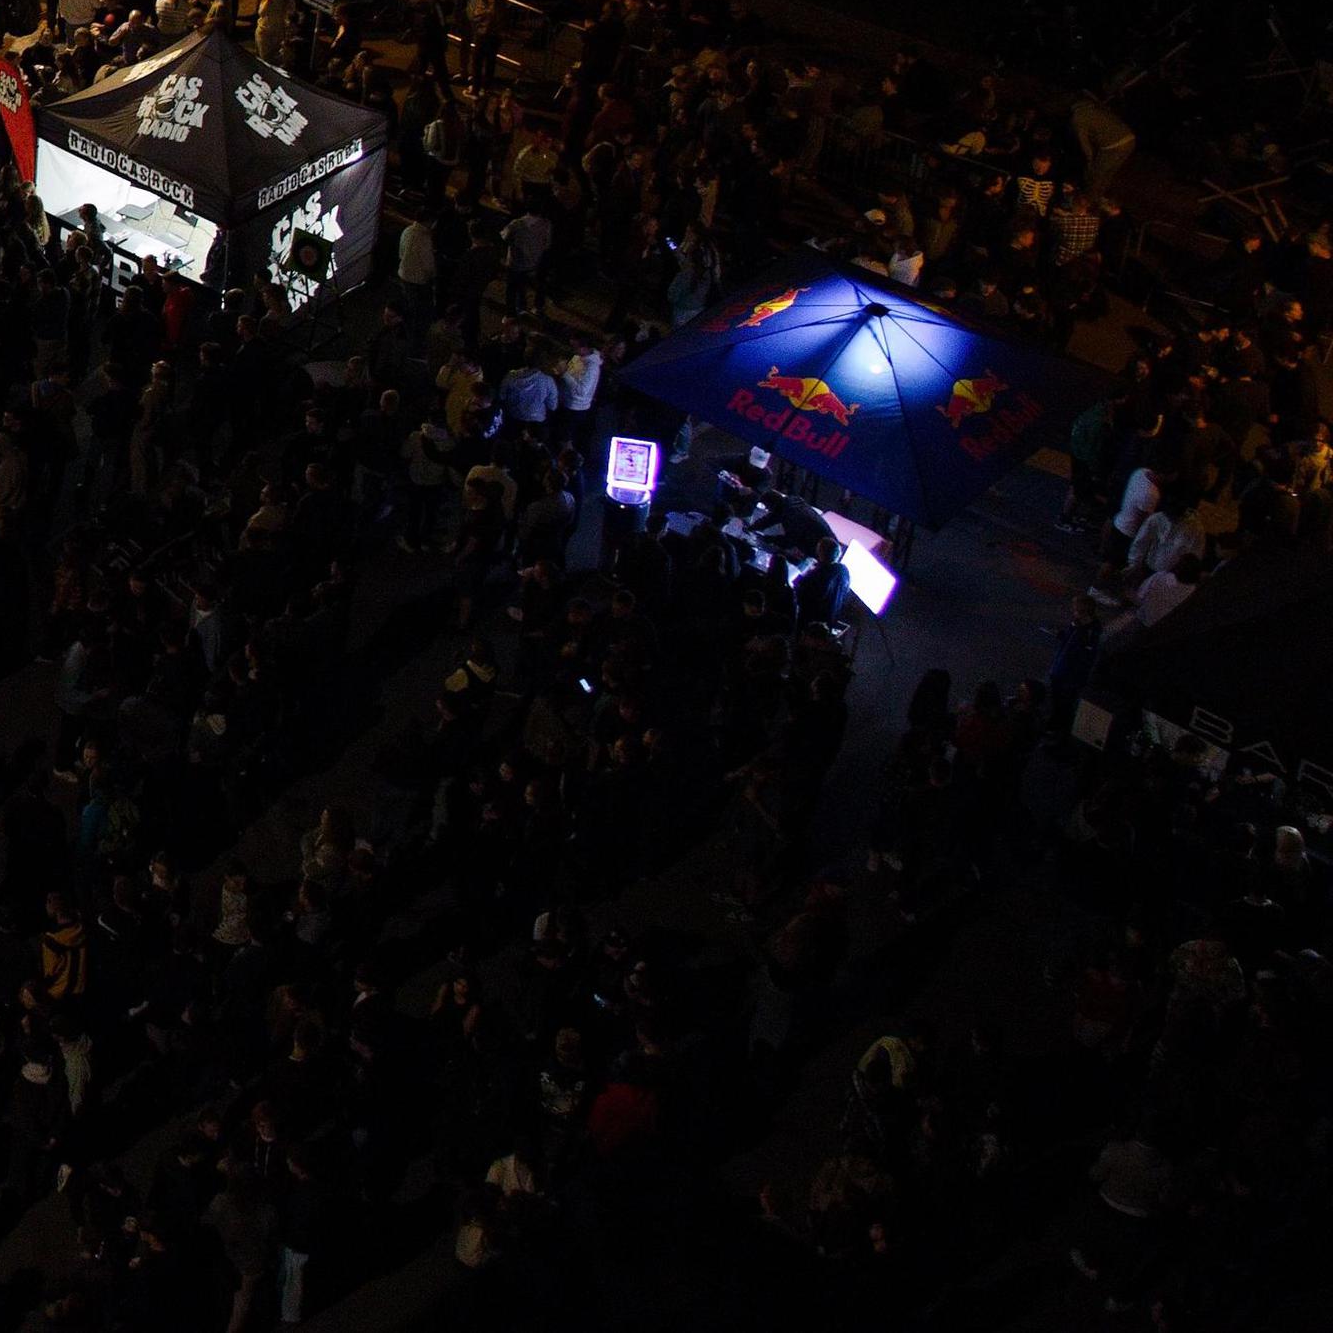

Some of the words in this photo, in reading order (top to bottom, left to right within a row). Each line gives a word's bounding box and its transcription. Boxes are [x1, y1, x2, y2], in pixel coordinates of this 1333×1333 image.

[136, 94, 210, 129] ROCK
[137, 118, 191, 143] RADIO
[69, 130, 116, 169] RADIO
[150, 170, 195, 210] ROCK
[258, 173, 298, 209] RADIO
[726, 388, 792, 432] Red
[781, 414, 851, 459] Bull
[995, 391, 1044, 432] Bull
